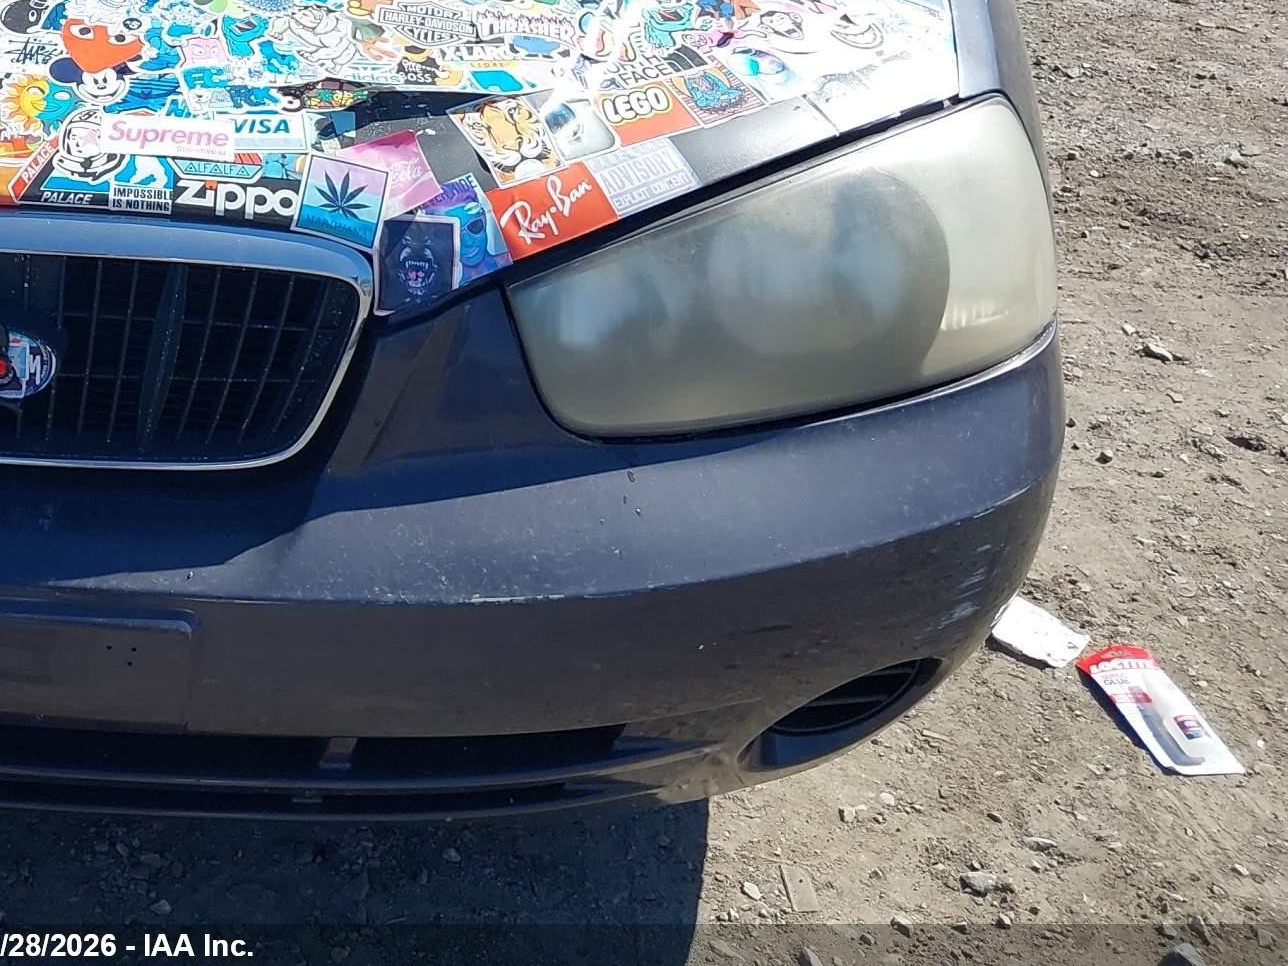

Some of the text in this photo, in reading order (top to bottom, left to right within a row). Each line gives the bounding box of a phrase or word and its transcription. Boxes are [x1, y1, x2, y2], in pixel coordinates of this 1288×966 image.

[385, 11, 475, 34] HARLEY-DAVIDSON
[477, 7, 576, 43] THRASHER
[618, 64, 672, 86] FACE
[602, 85, 671, 124] LEGO
[110, 120, 229, 149] Supreme
[234, 118, 291, 134] VISA
[21, 141, 54, 182] PALACE
[40, 191, 93, 206] PALACE
[112, 198, 170, 212] IS NOTHING
